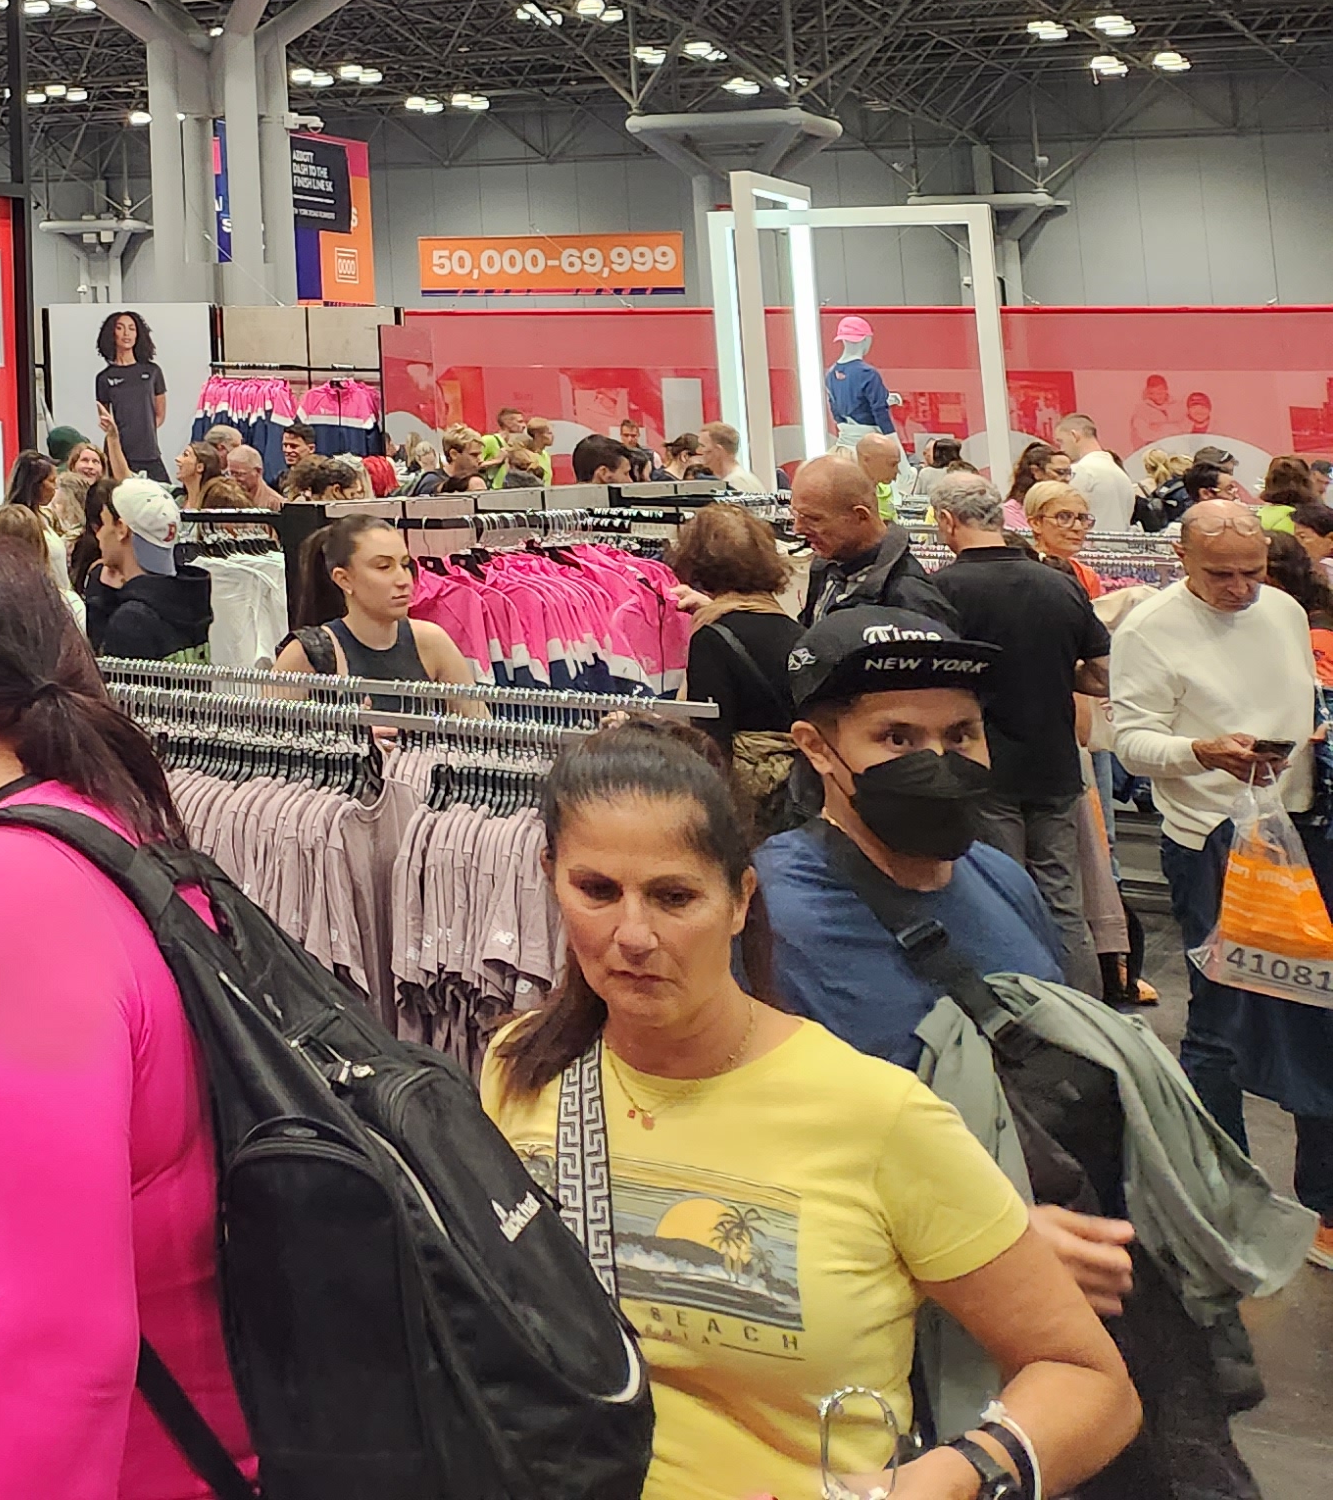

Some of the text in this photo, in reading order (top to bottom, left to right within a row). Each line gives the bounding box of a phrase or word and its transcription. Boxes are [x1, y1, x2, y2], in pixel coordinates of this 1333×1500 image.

[862, 623, 944, 644] Time
[864, 657, 990, 674] NEW YORK
[650, 1306, 799, 1351] BEACH
